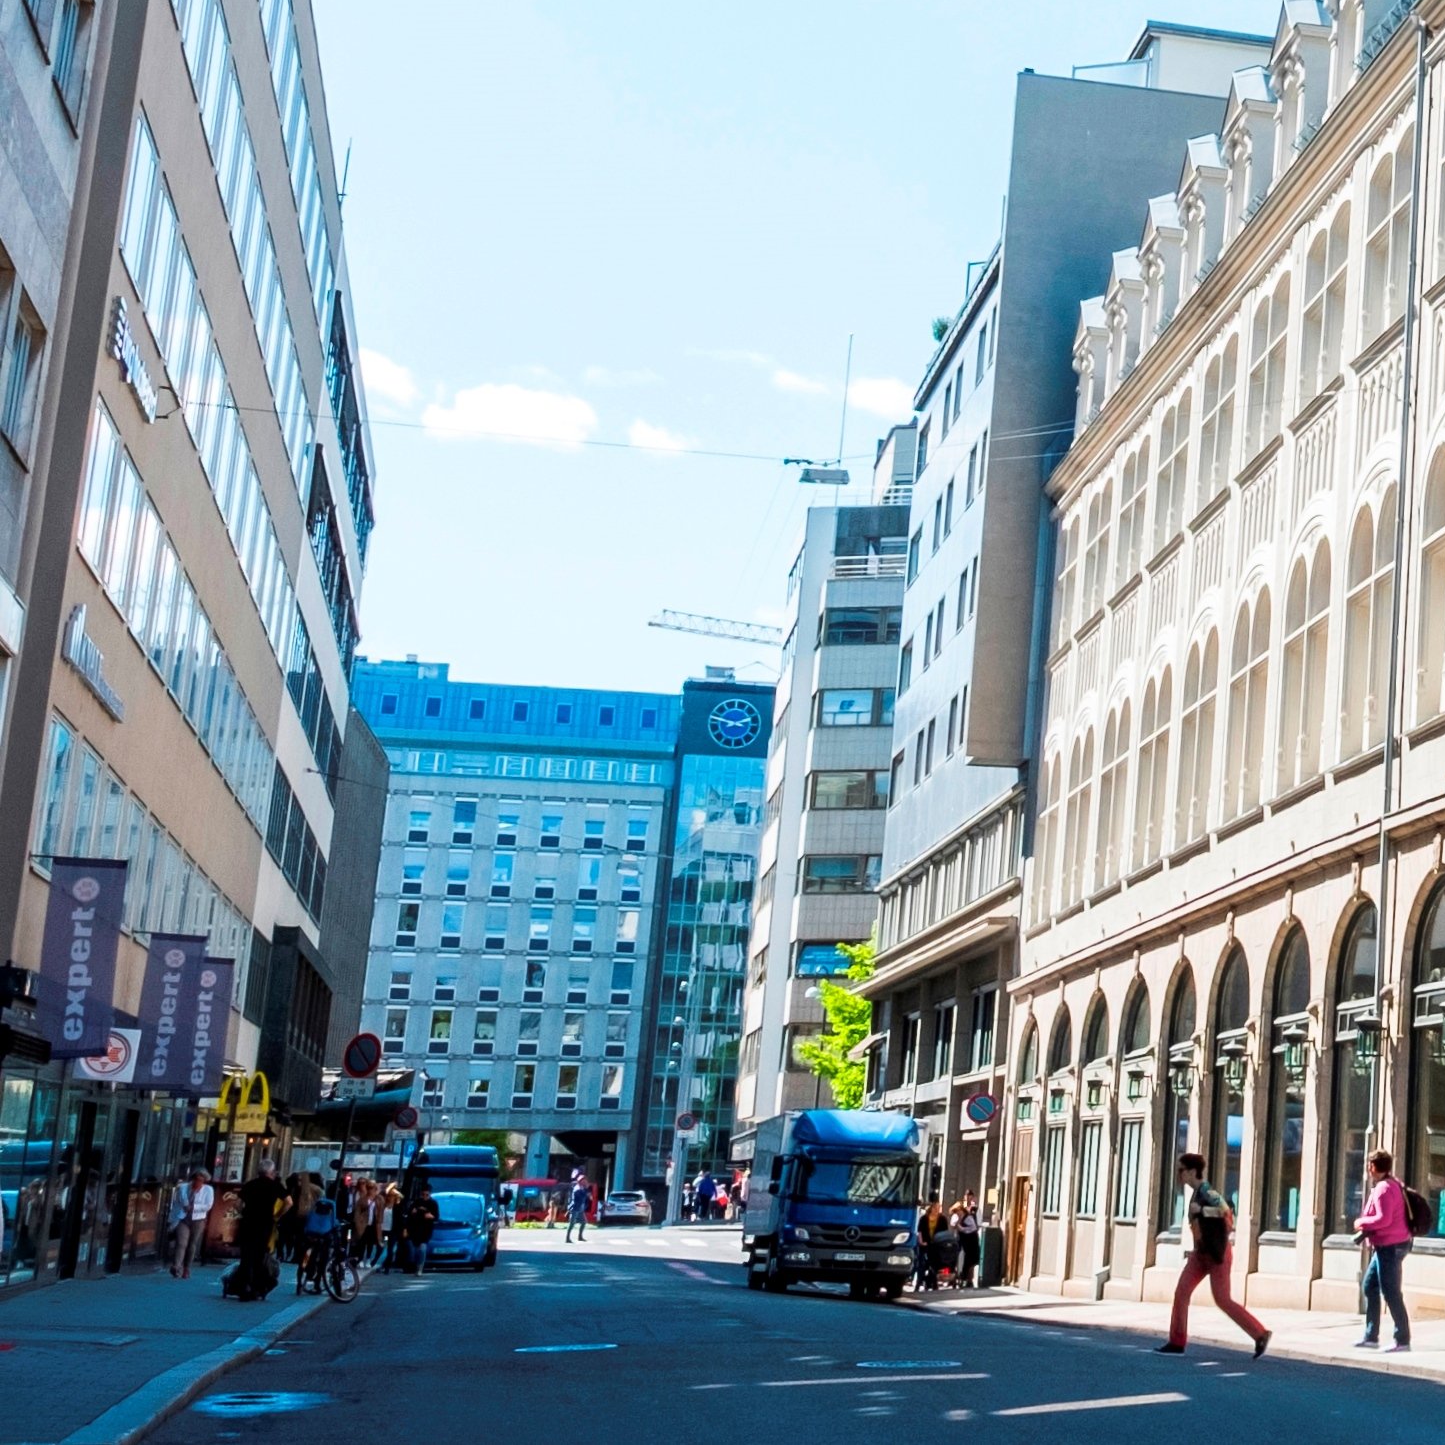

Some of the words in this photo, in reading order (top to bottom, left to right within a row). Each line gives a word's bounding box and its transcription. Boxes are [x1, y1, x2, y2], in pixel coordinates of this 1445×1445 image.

[63, 906, 96, 1042] expert
[151, 970, 182, 1077] expert
[190, 990, 214, 1086] expert
